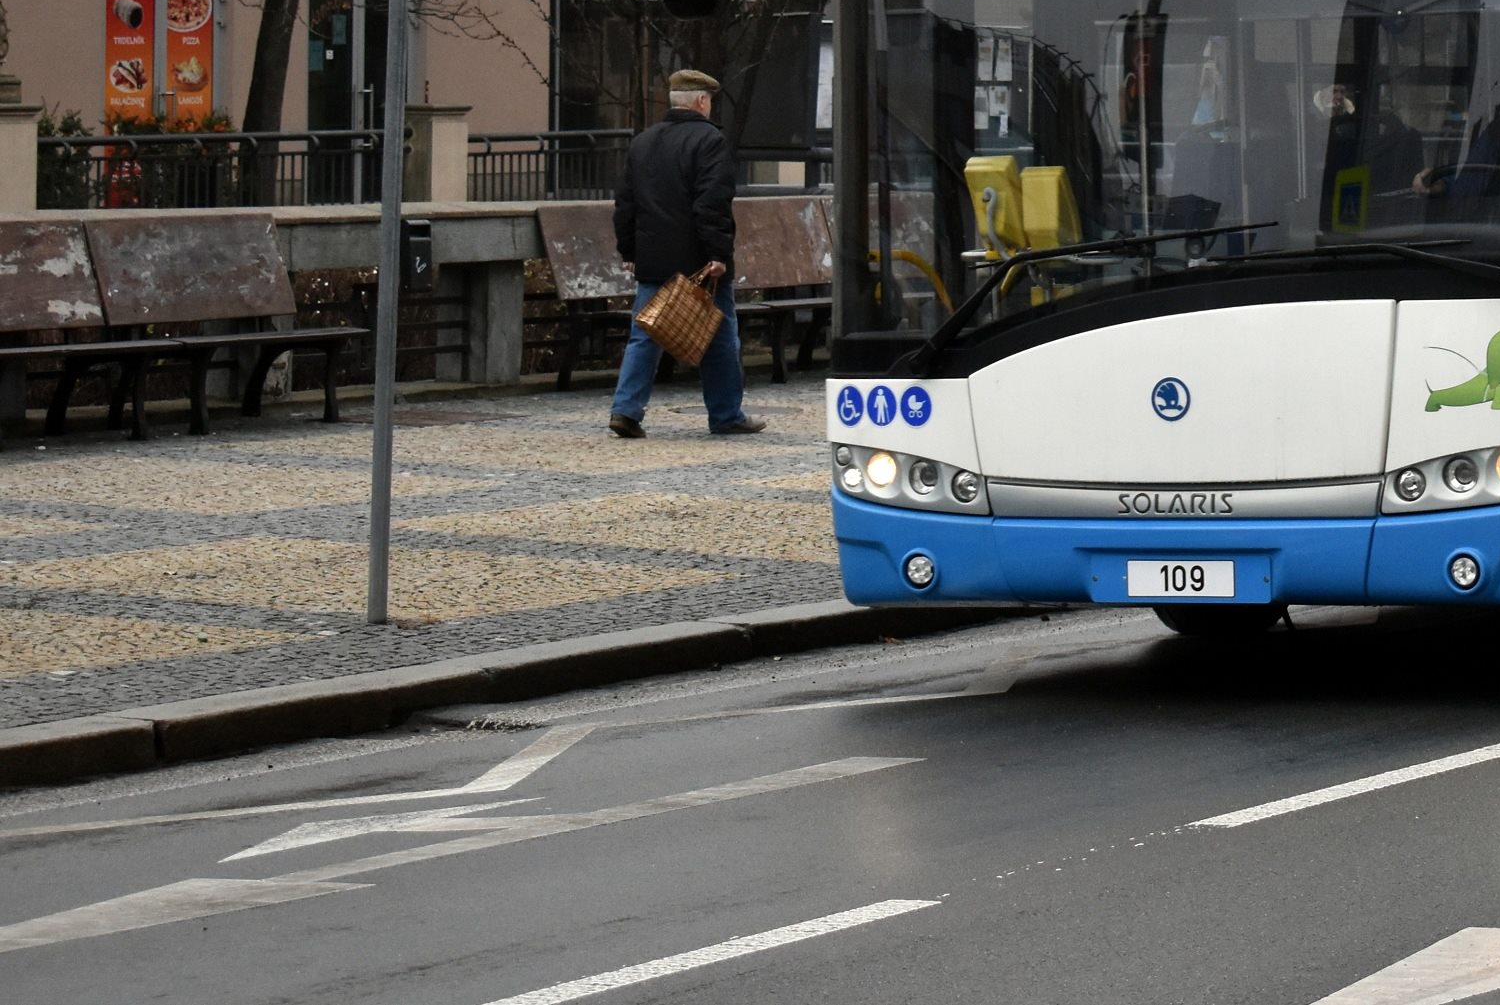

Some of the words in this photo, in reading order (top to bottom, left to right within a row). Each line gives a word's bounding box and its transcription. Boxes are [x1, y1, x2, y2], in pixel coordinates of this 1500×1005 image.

[182, 36, 200, 45] PIZZA
[1117, 492, 1233, 514] SOLARIS
[1160, 564, 1205, 592] 109
